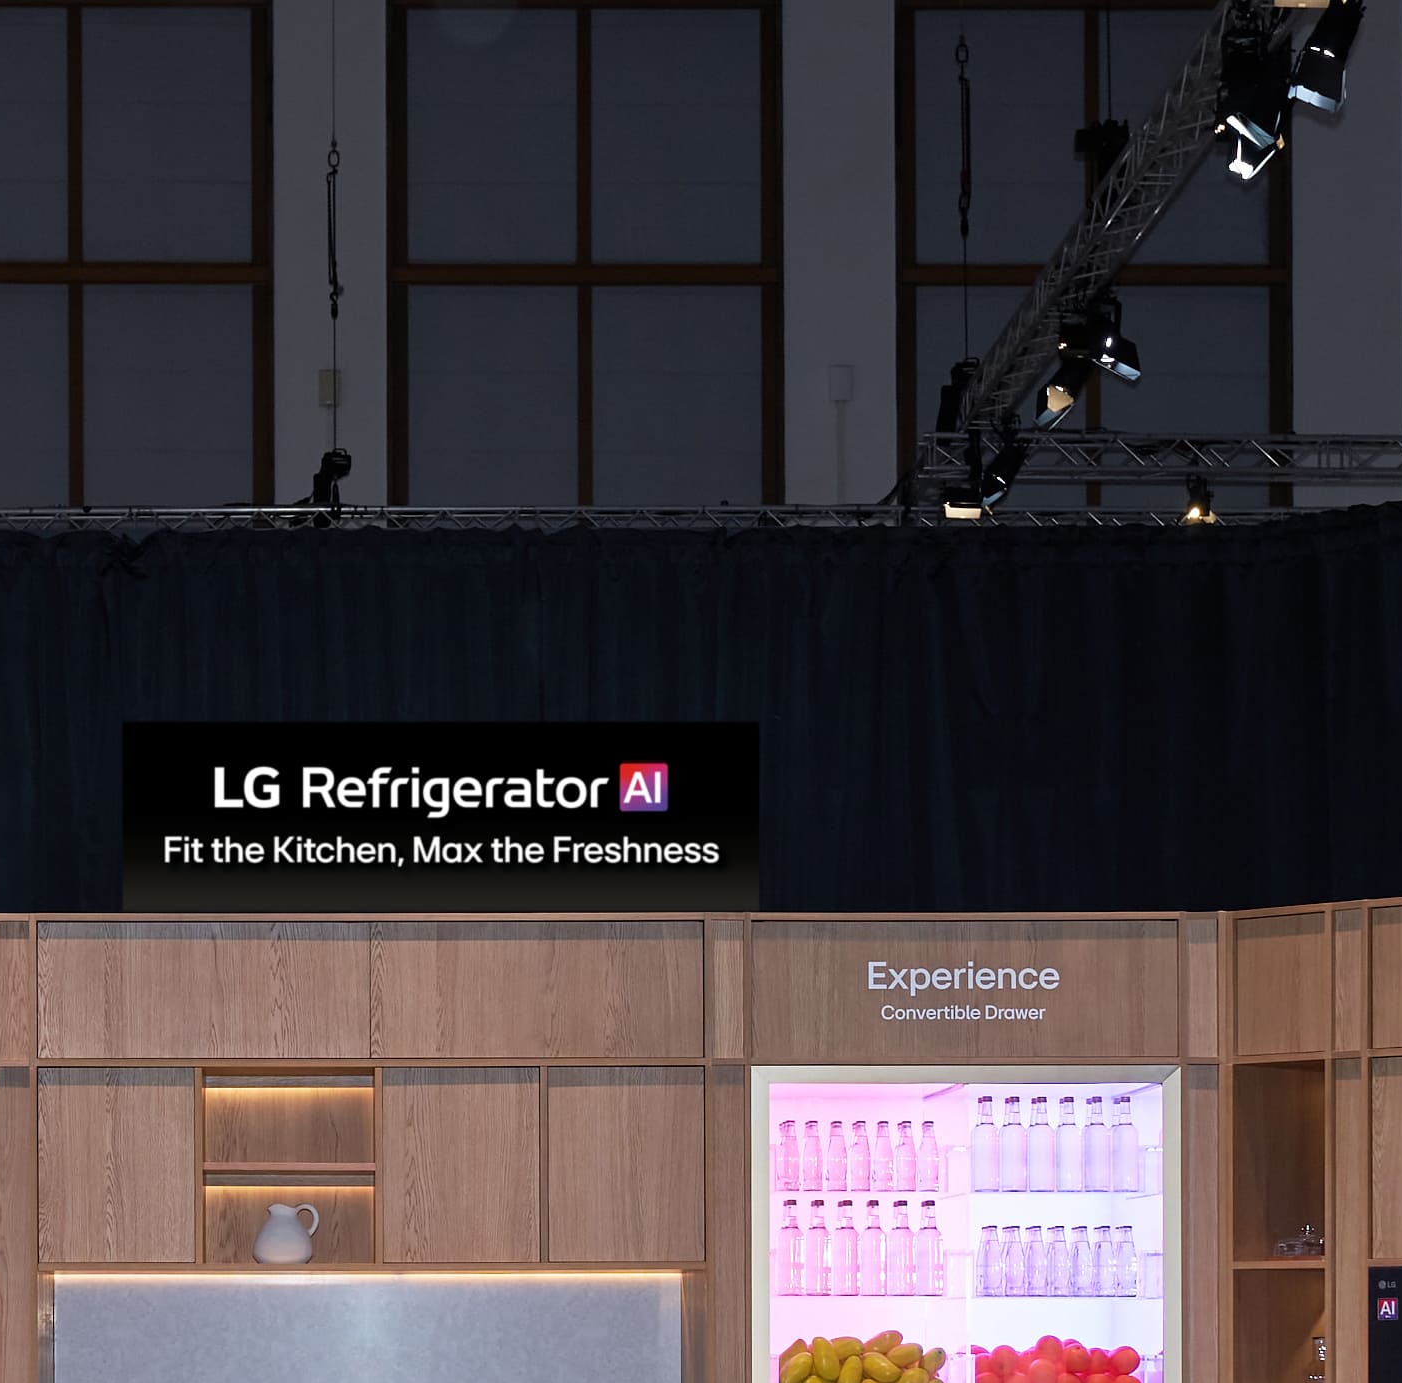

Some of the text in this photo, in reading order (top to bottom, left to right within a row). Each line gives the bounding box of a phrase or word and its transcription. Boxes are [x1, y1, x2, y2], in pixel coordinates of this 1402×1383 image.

[214, 766, 661, 819] LG Refrigerator AI
[164, 836, 720, 868] Fit the Kitchen, Max the Freshness
[868, 961, 1060, 997] Experience
[881, 1005, 1047, 1020] Convertible Drawer
[1379, 1300, 1396, 1315] AI
